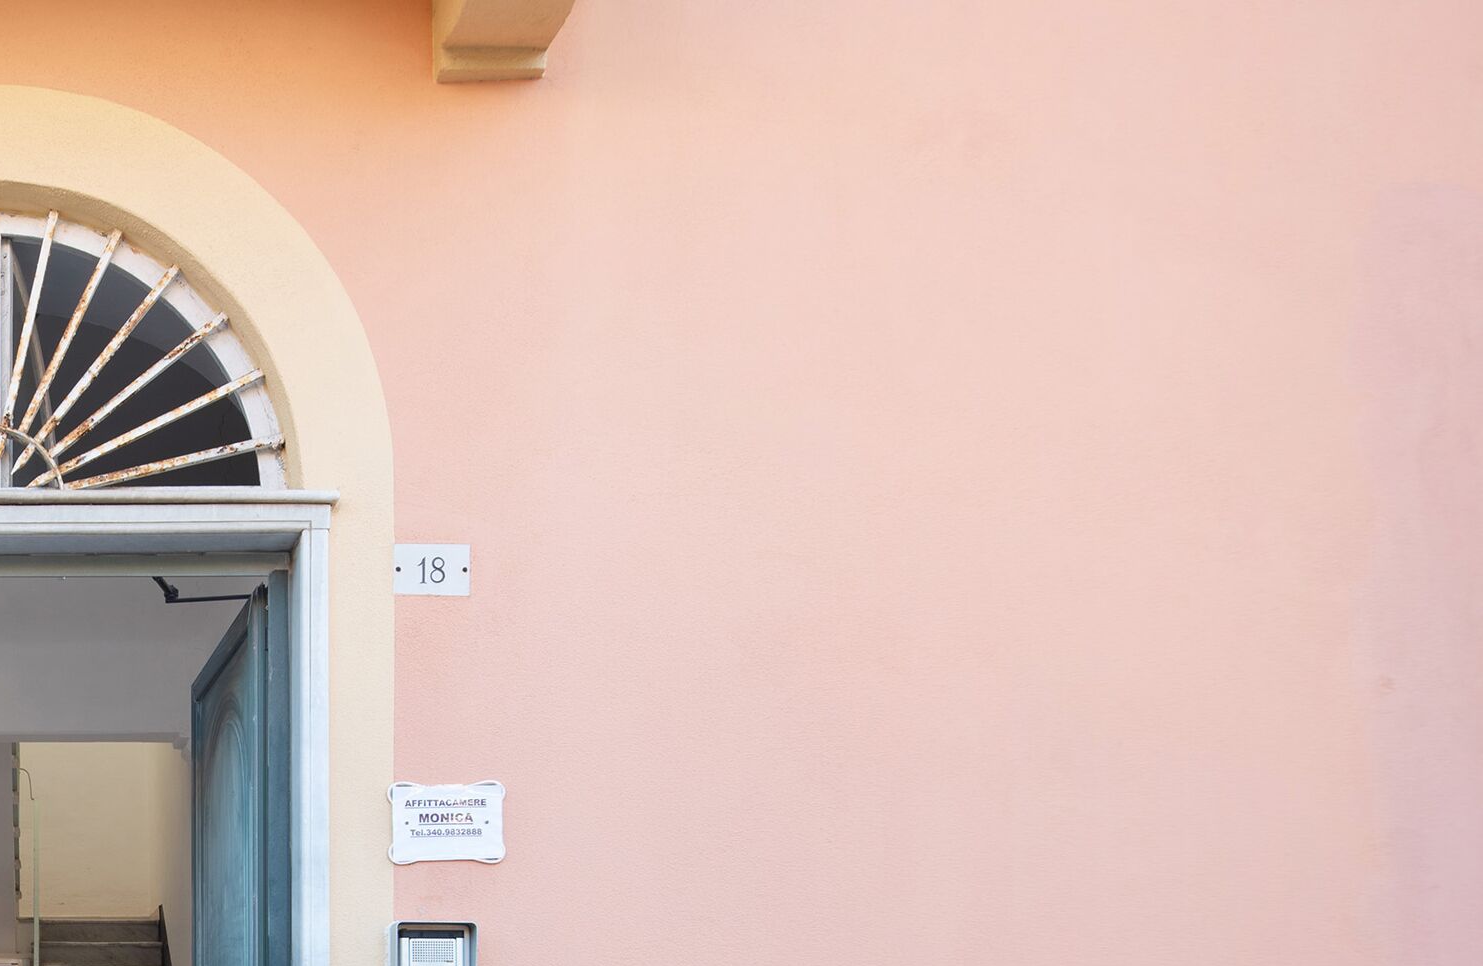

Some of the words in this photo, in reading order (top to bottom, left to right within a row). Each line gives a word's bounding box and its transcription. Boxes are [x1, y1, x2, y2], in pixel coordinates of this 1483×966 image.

[417, 557, 446, 584] 18
[404, 799, 487, 807] AFFITTACAMERE
[419, 813, 473, 823] MONICA
